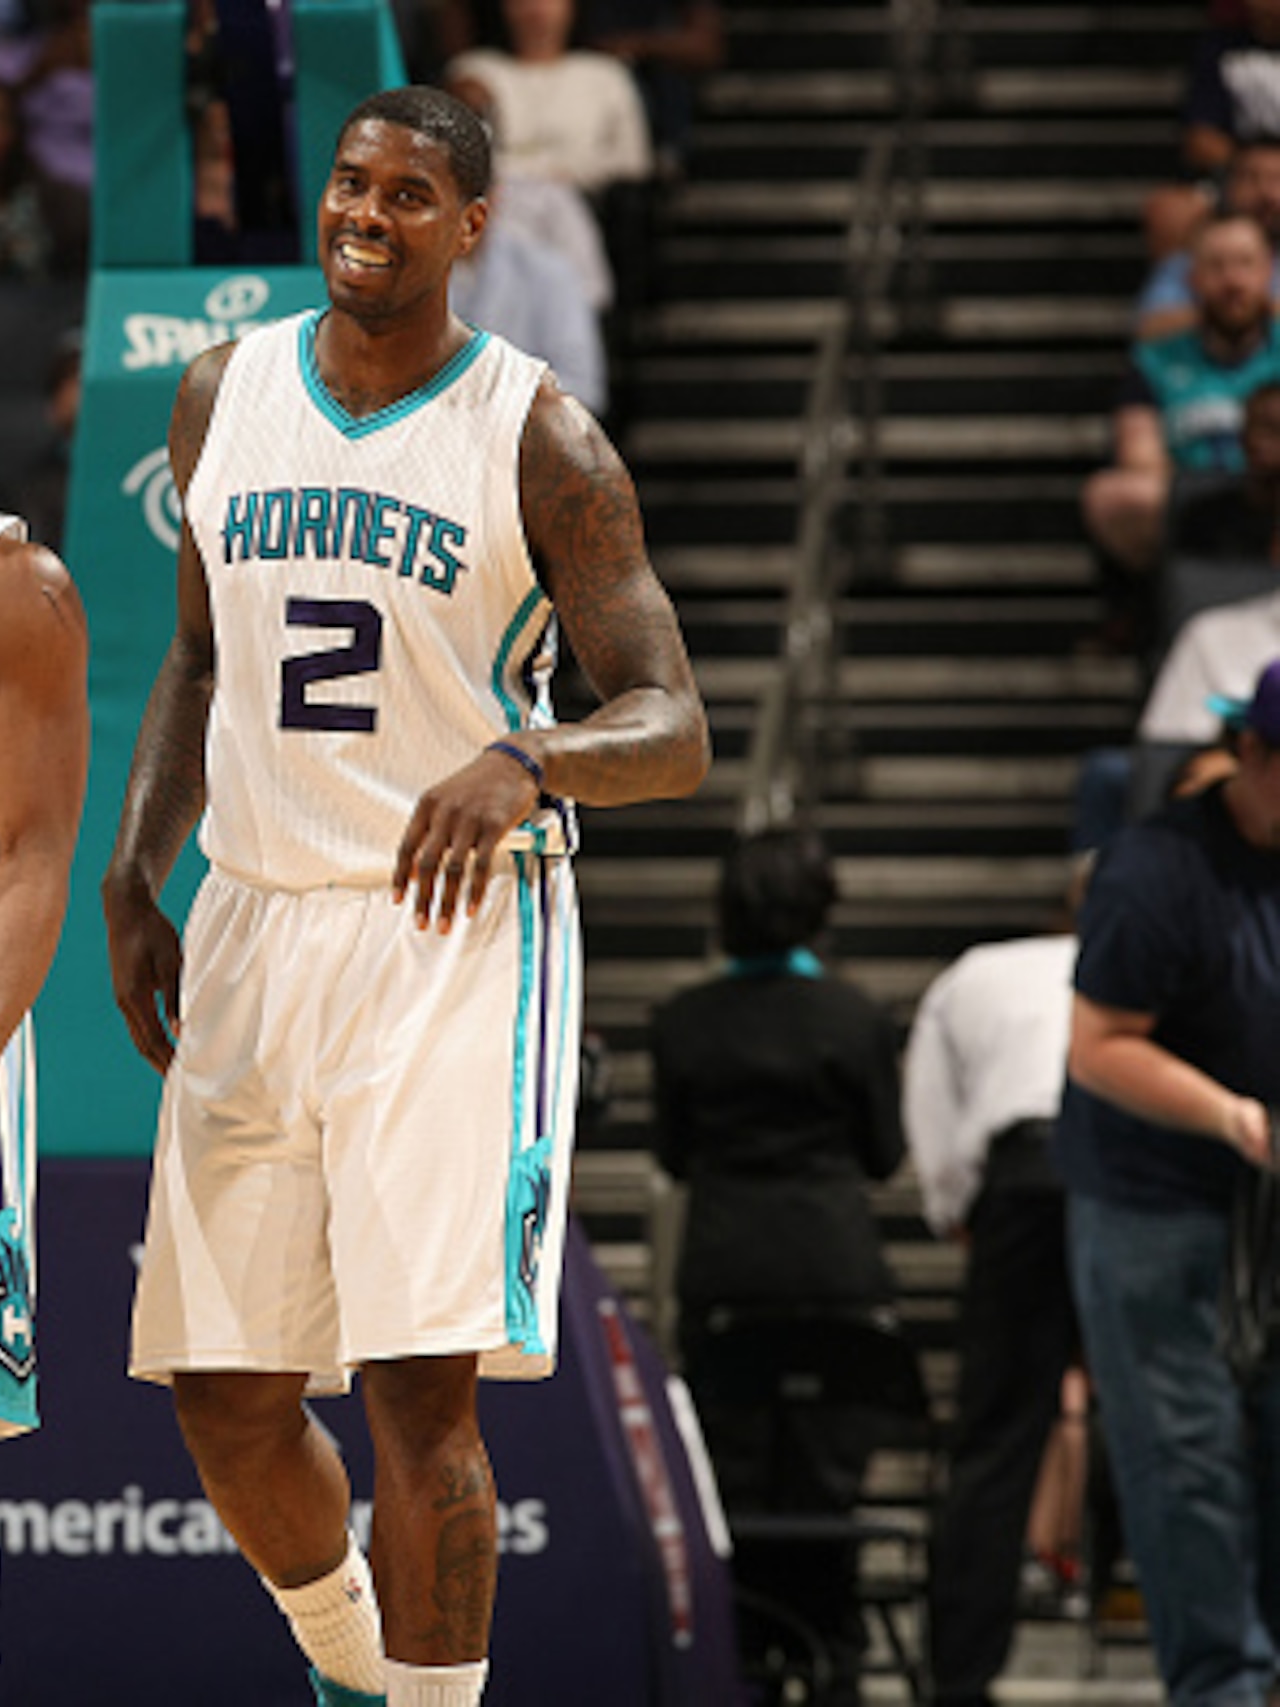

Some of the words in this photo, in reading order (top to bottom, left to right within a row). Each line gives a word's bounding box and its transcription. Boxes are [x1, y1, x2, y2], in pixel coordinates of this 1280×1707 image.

[122, 312, 257, 372] SPAL
[220, 487, 468, 598] HORNETS
[280, 597, 383, 731] 2
